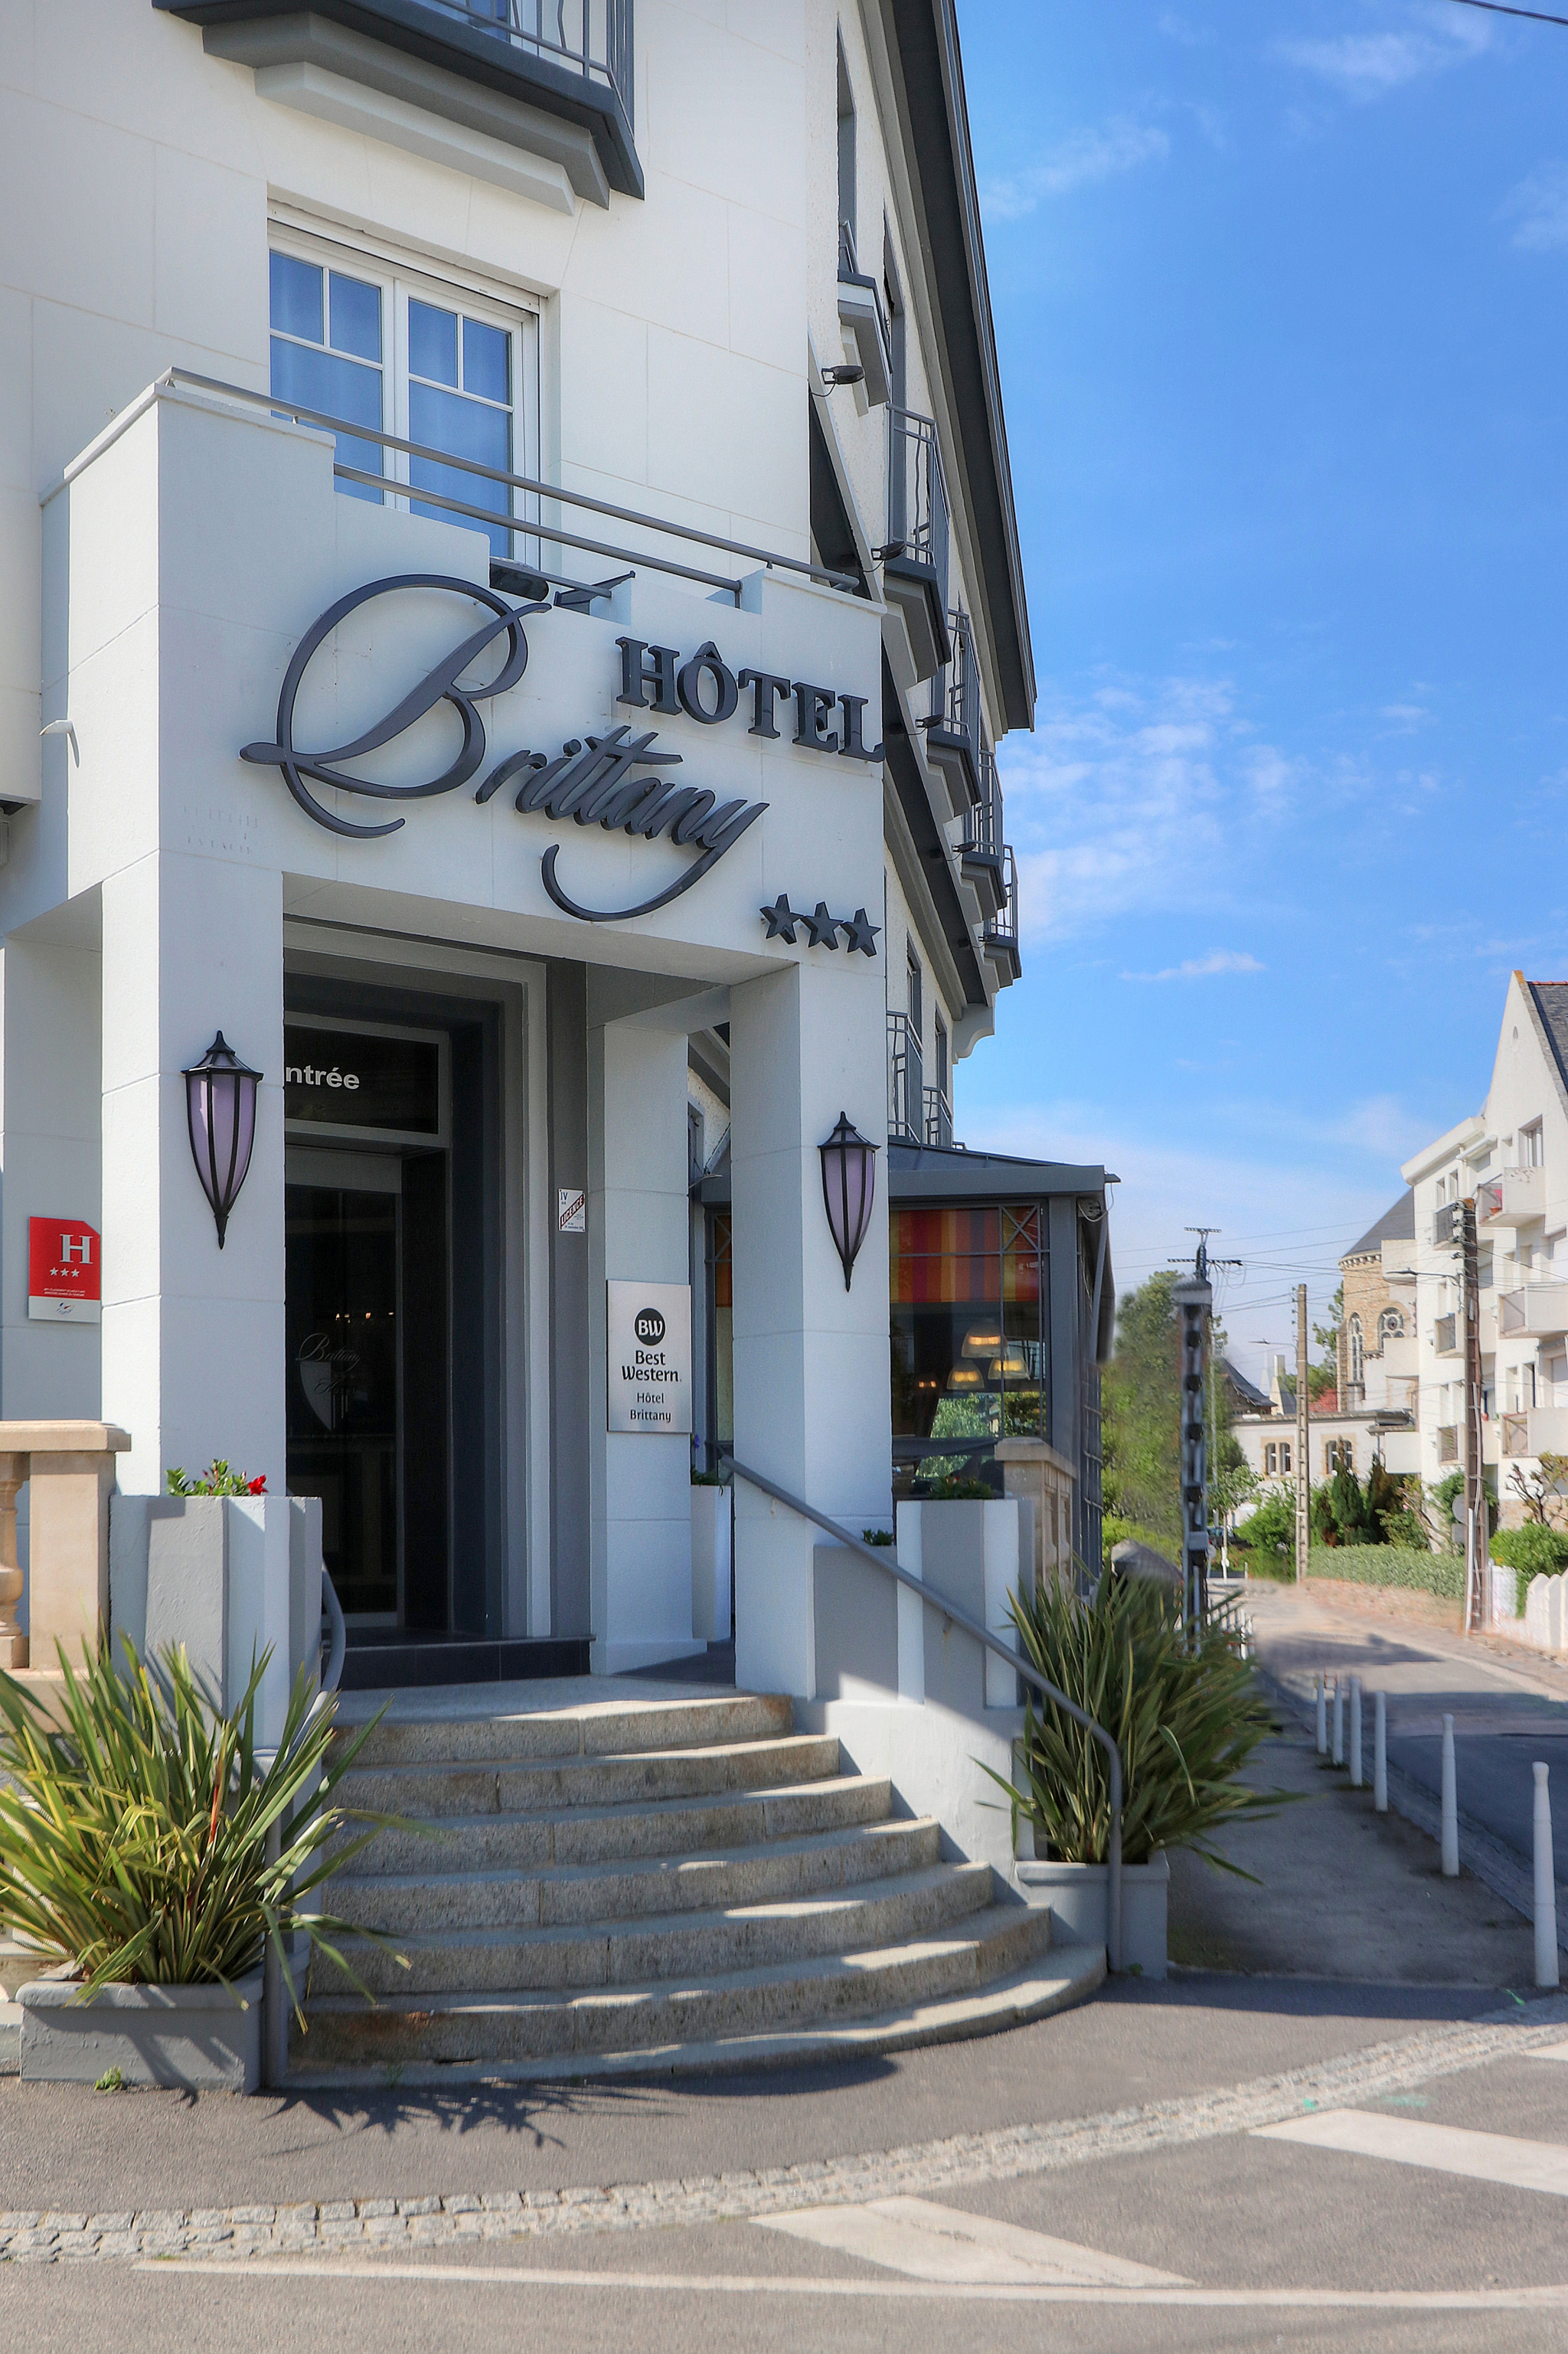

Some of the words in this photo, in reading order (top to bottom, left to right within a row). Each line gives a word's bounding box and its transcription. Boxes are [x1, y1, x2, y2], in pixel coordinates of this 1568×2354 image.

[616, 636, 885, 763] HÔTEL
[239, 574, 769, 921] Brittany
[286, 1064, 360, 1090] ntrée
[560, 1192, 568, 1200] IV
[561, 1195, 583, 1225] LICENCE
[59, 1234, 93, 1264] H
[638, 1319, 663, 1337] BW
[635, 1350, 666, 1365] Best
[622, 1365, 679, 1382] Western
[636, 1392, 665, 1404] Hôtel
[630, 1409, 671, 1424] Brittany
